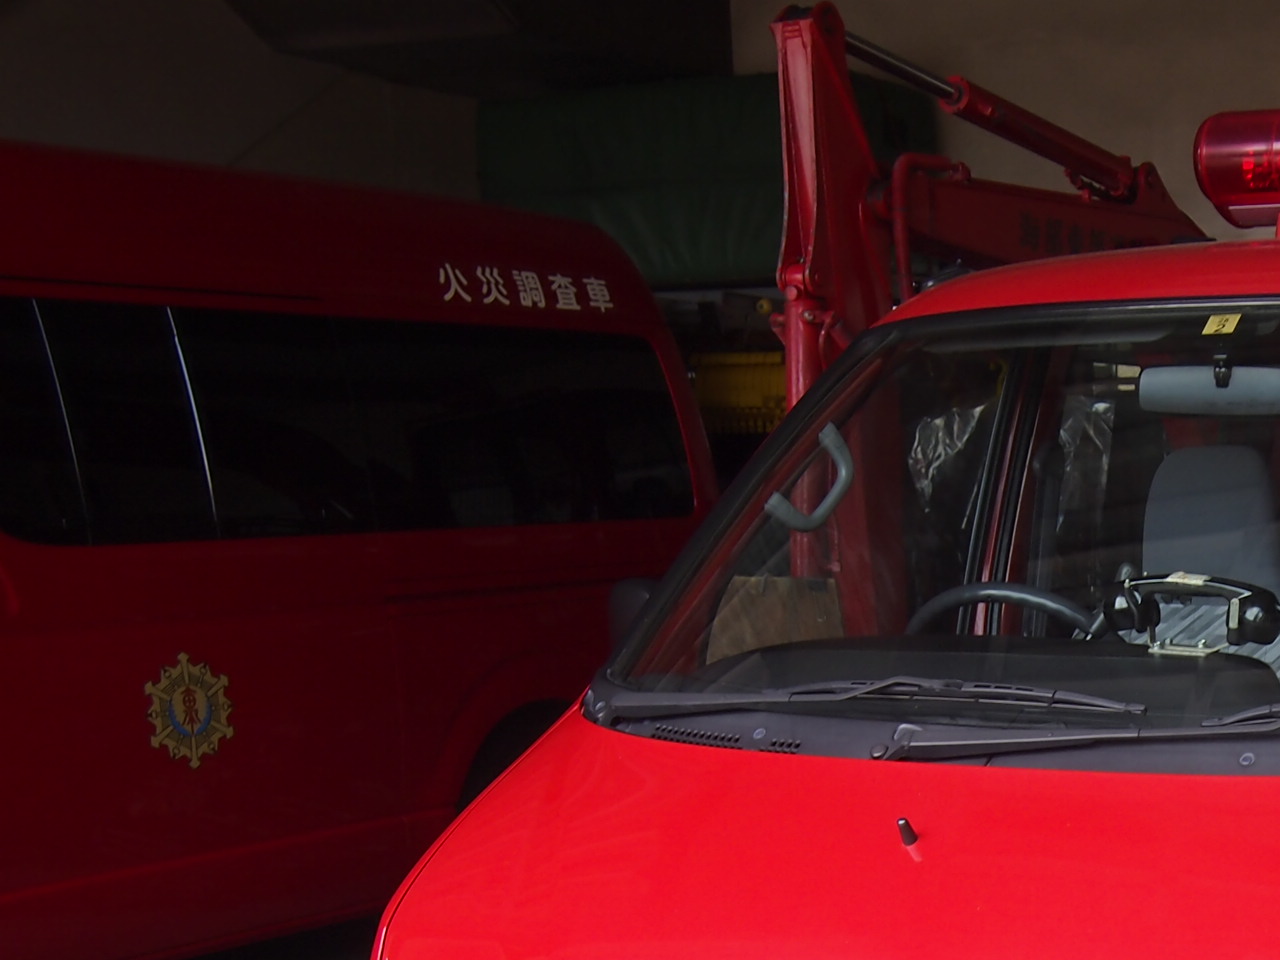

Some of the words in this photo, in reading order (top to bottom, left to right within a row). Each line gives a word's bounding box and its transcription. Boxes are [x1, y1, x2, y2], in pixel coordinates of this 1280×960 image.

[438, 263, 614, 312] 火災調査車
